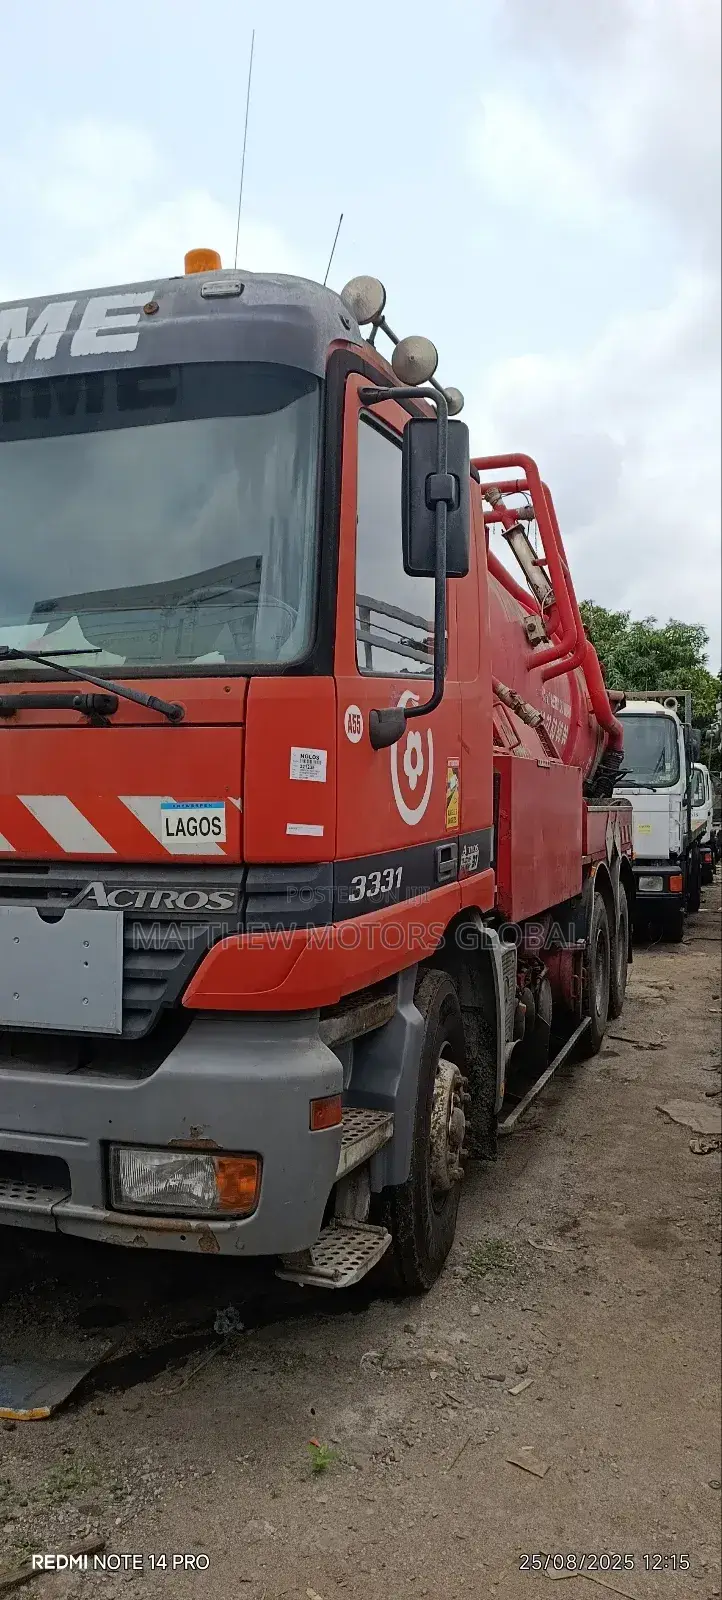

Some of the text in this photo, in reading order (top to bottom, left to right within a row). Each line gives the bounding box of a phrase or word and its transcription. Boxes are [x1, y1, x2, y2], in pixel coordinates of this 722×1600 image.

[347, 713, 361, 735] A55
[165, 816, 222, 837] LAGOS
[72, 881, 235, 910] ACTROS
[348, 867, 404, 902] 3331
